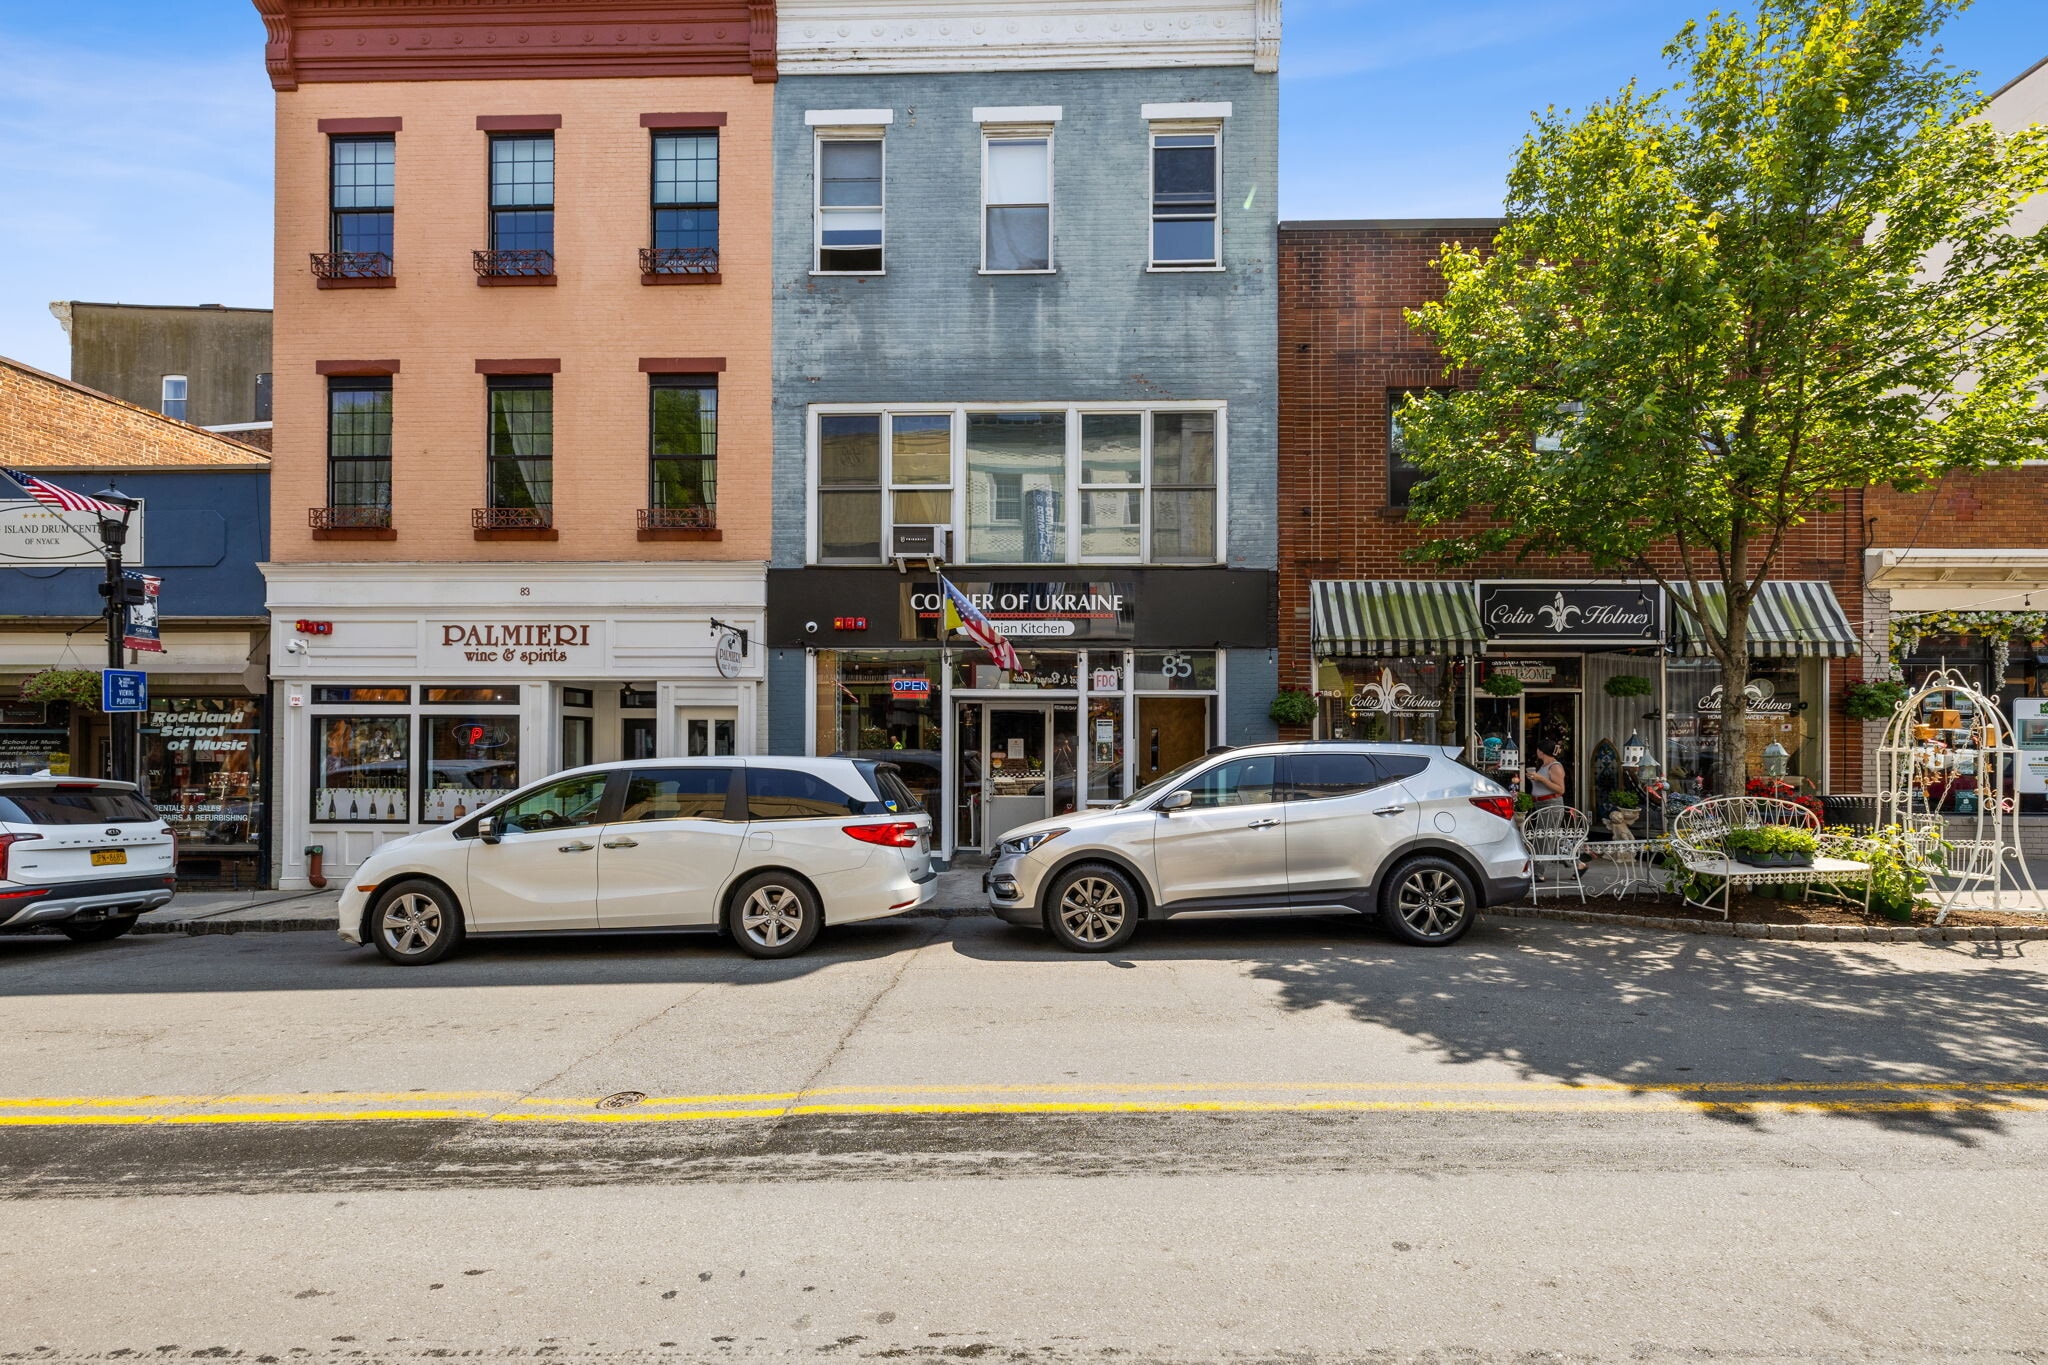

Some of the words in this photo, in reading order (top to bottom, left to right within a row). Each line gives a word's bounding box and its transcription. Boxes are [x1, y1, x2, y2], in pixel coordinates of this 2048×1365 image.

[4, 525, 38, 534] ISLAND
[42, 525, 69, 534] DRUM
[520, 587, 530, 596] 83
[910, 593, 994, 611] COER
[1000, 594, 1029, 611] OF
[1035, 594, 1123, 611] UKRAINE
[1490, 604, 1536, 624] Colin
[1581, 605, 1649, 624] Holmes
[1021, 623, 1064, 634] Kitchen
[442, 624, 590, 647] PALMIERI
[464, 648, 498, 662] wine
[502, 648, 516, 662] &
[520, 648, 567, 665] spirits
[1162, 655, 1192, 678] 85
[893, 681, 928, 691] OPEN
[1096, 674, 1115, 688] FDC
[1350, 694, 1380, 707] Colin
[1398, 694, 1440, 707] Holmes
[1698, 696, 1722, 710] Coli
[1747, 697, 1791, 711] Holmes
[152, 711, 244, 723] Rockland
[160, 725, 225, 737] School
[167, 739, 190, 751] of
[193, 739, 248, 751] Music
